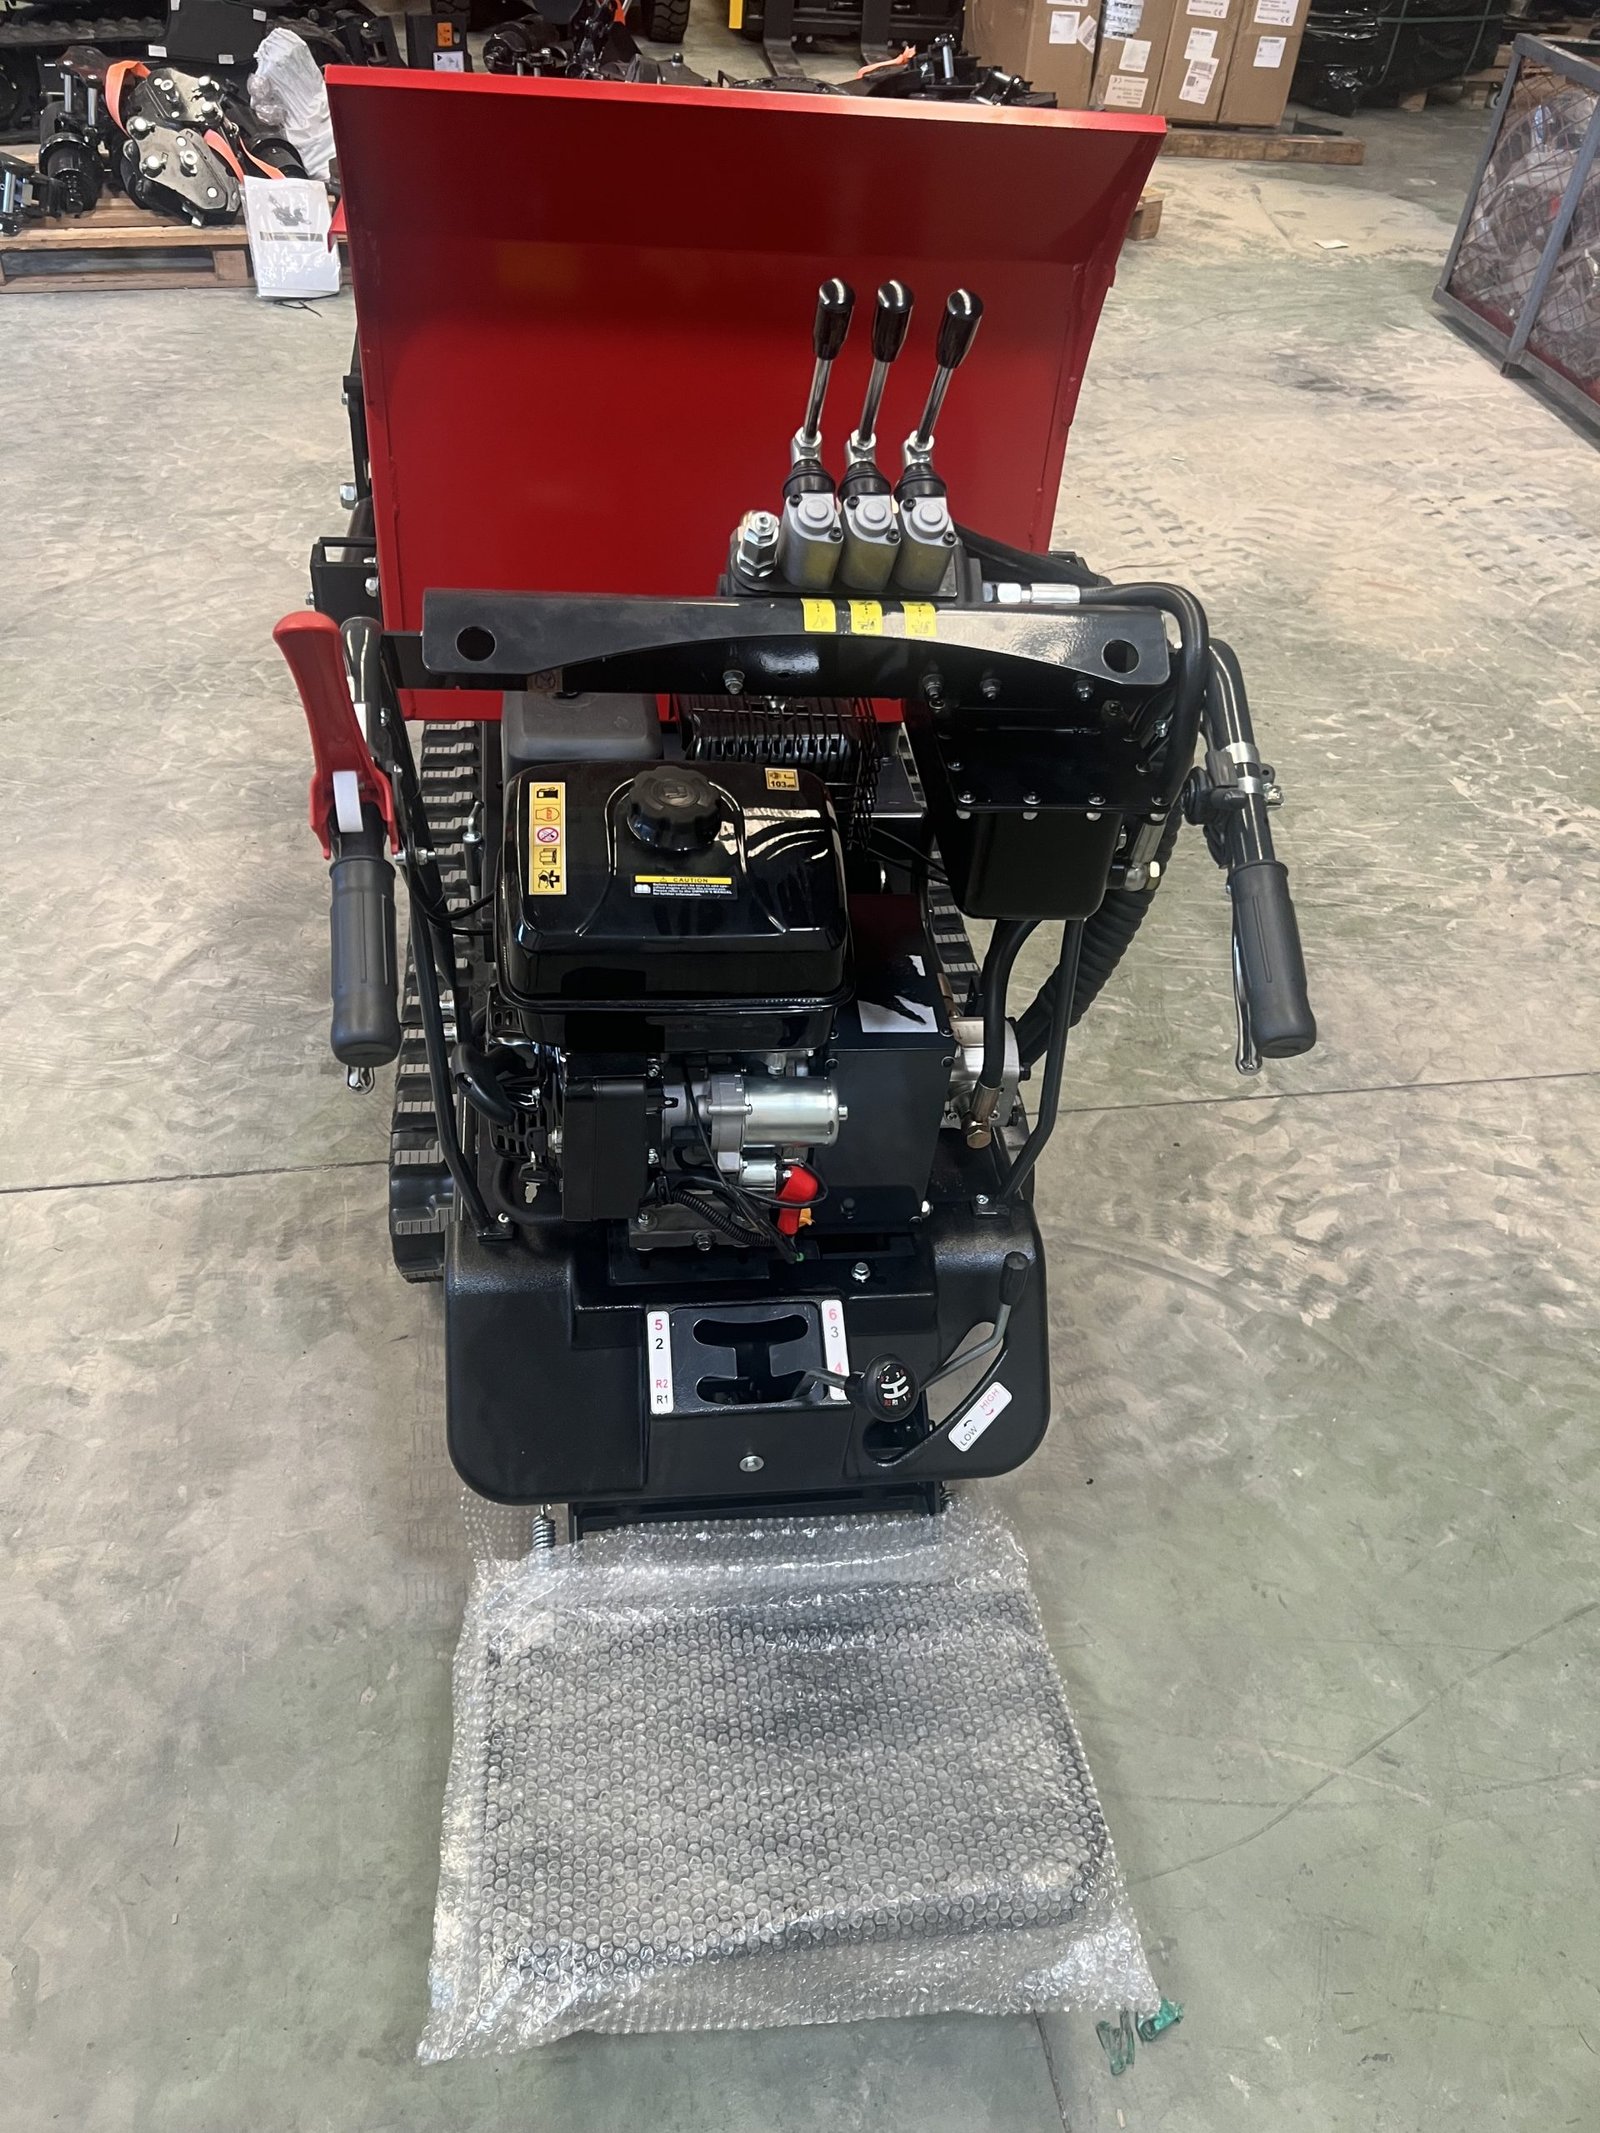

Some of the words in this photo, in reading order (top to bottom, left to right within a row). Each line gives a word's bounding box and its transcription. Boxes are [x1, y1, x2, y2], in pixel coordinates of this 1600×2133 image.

[828, 1308, 837, 1321] 6
[655, 1319, 663, 1331] 5
[830, 1326, 839, 1338] 3
[655, 1338, 664, 1349] 2
[656, 1379, 668, 1389] R2
[656, 1395, 668, 1404] R1
[980, 1388, 1000, 1410] HIGH
[960, 1426, 978, 1446] LOW
